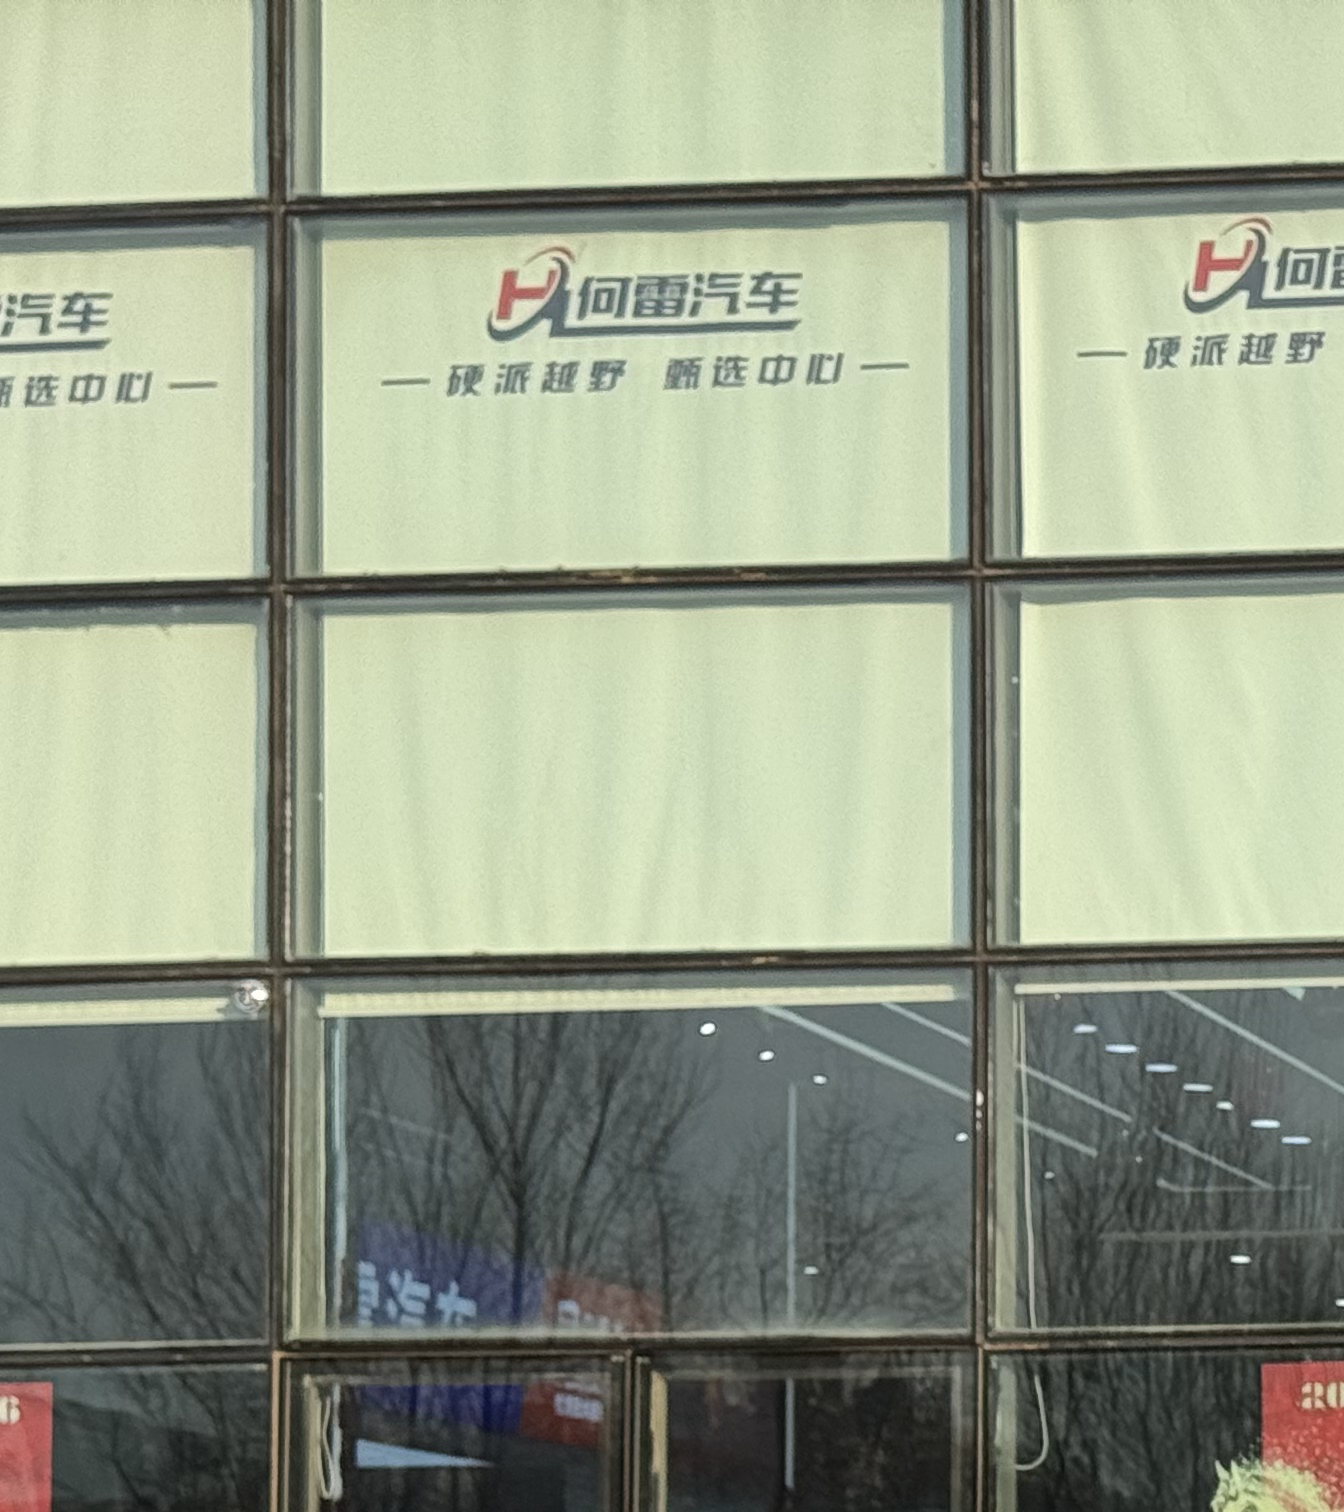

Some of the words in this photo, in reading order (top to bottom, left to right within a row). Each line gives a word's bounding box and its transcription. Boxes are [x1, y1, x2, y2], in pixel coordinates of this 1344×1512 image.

[0, 292, 113, 336] 汽车
[577, 272, 802, 320] 何雷汽车
[1144, 332, 1325, 369] 硬派越野
[447, 359, 626, 396] 硬派越野
[662, 352, 844, 390] 甄选中心
